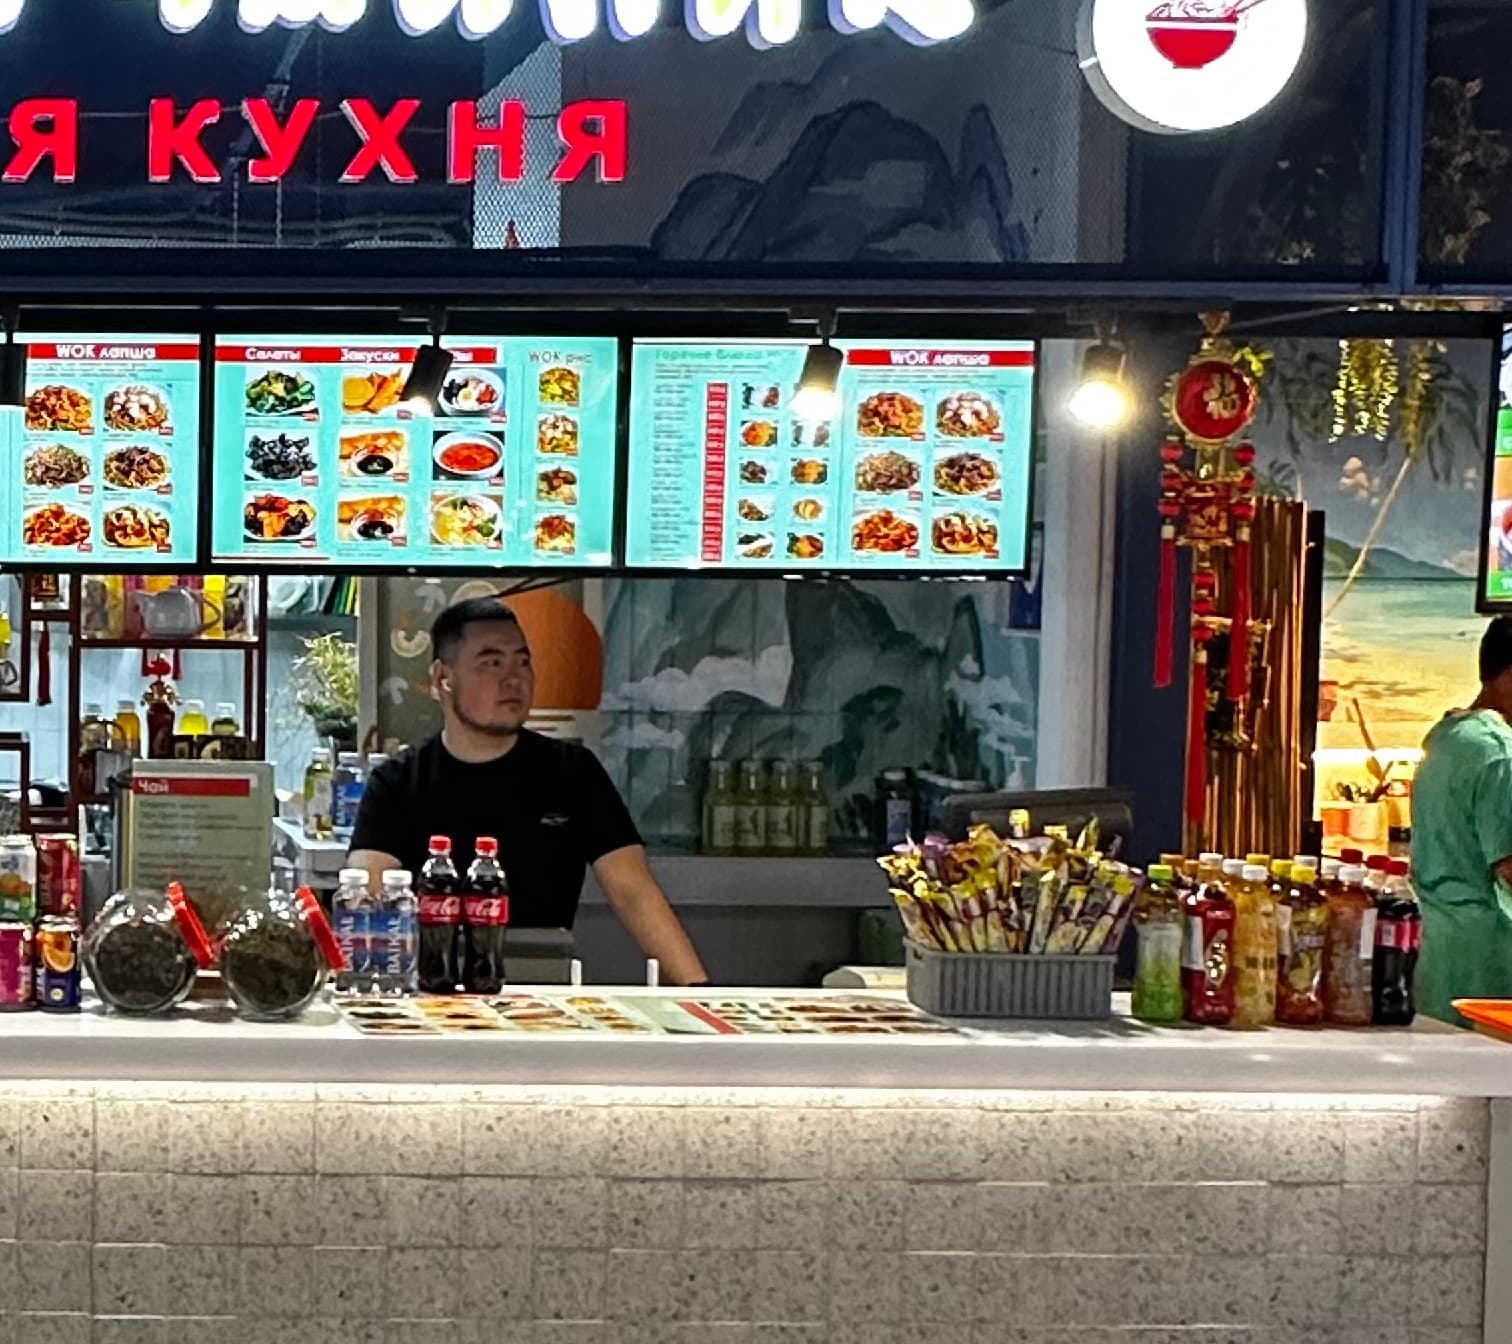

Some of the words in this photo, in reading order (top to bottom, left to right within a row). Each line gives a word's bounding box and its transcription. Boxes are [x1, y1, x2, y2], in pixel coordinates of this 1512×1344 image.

[148, 98, 629, 184] КУХНЯ
[56, 345, 96, 358] WOK
[99, 347, 157, 358] лапша
[890, 351, 929, 364] WOK
[137, 778, 170, 794] Чай
